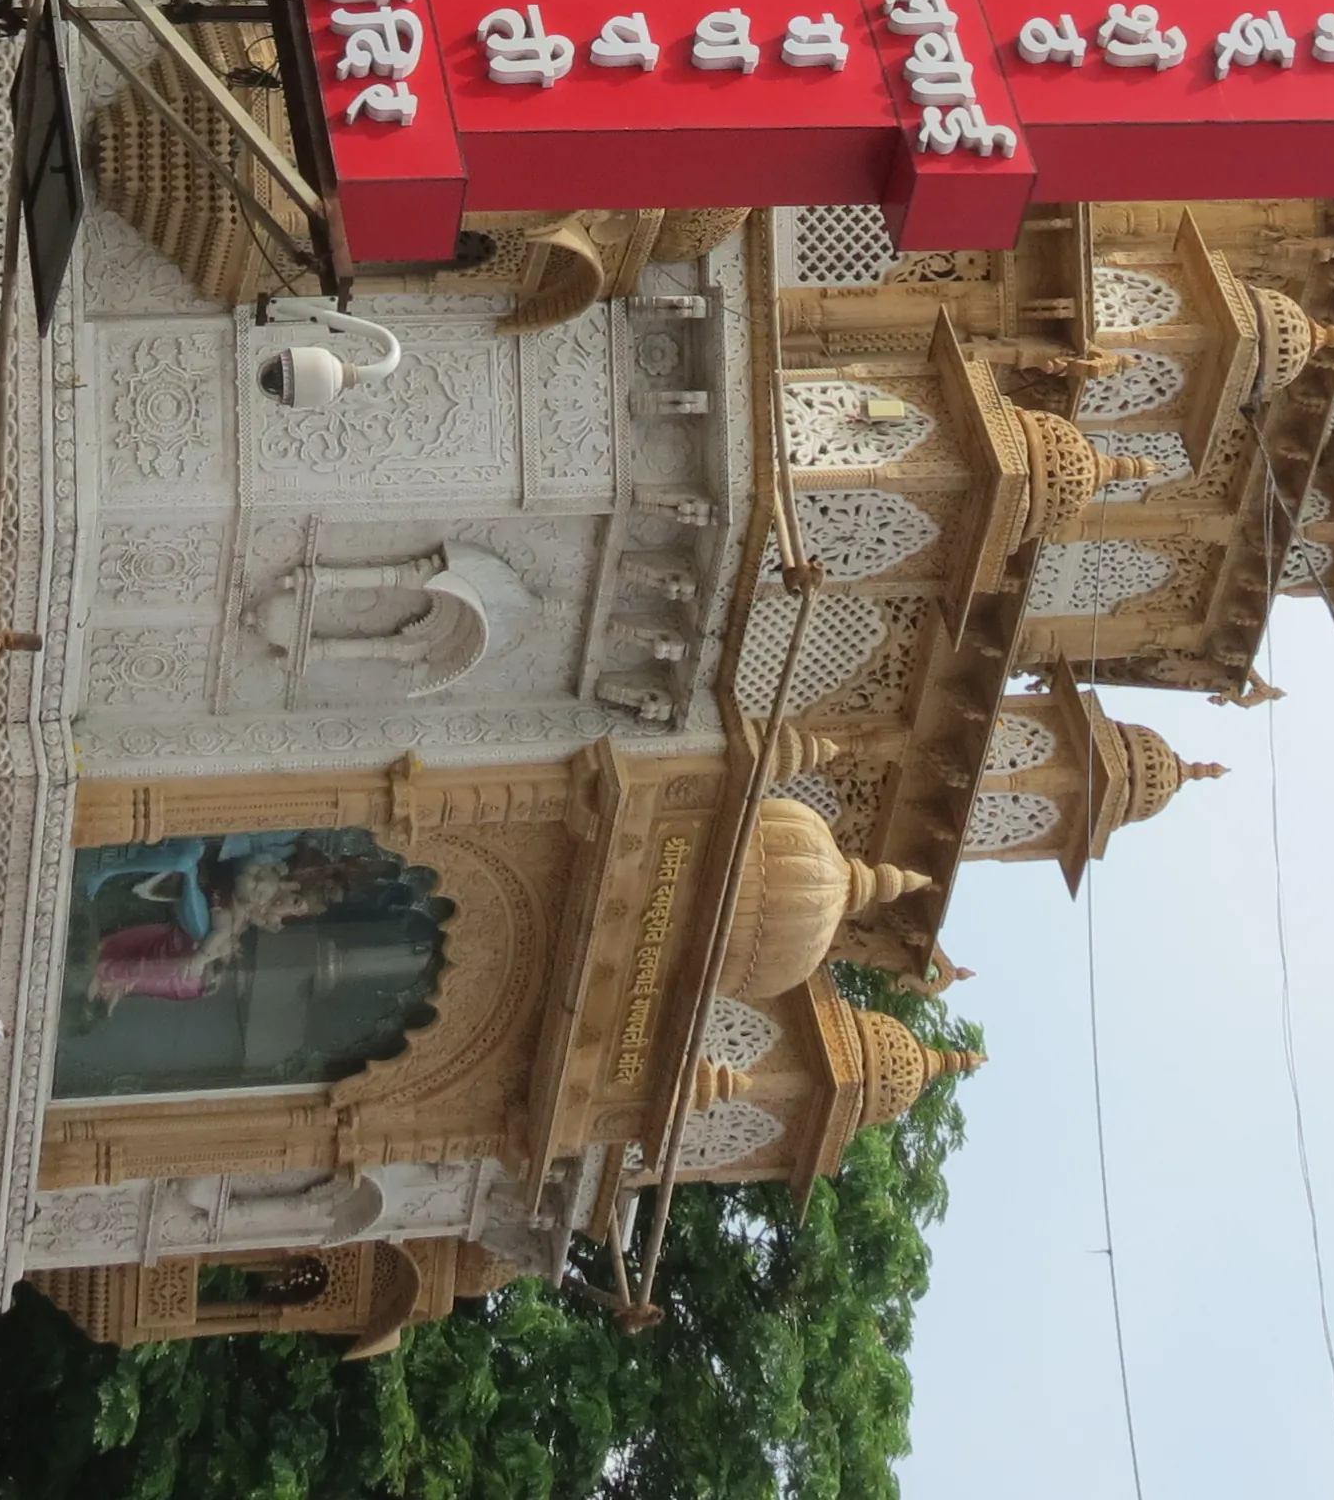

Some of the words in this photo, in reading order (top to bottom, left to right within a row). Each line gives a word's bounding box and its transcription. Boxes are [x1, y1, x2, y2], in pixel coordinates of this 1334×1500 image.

[658, 836, 691, 881] श्रीमंत
[641, 884, 678, 943] दगडूशेठ
[628, 946, 663, 996] हलवाई
[621, 998, 653, 1049] गणपती
[613, 1051, 646, 1086] मंदिर
